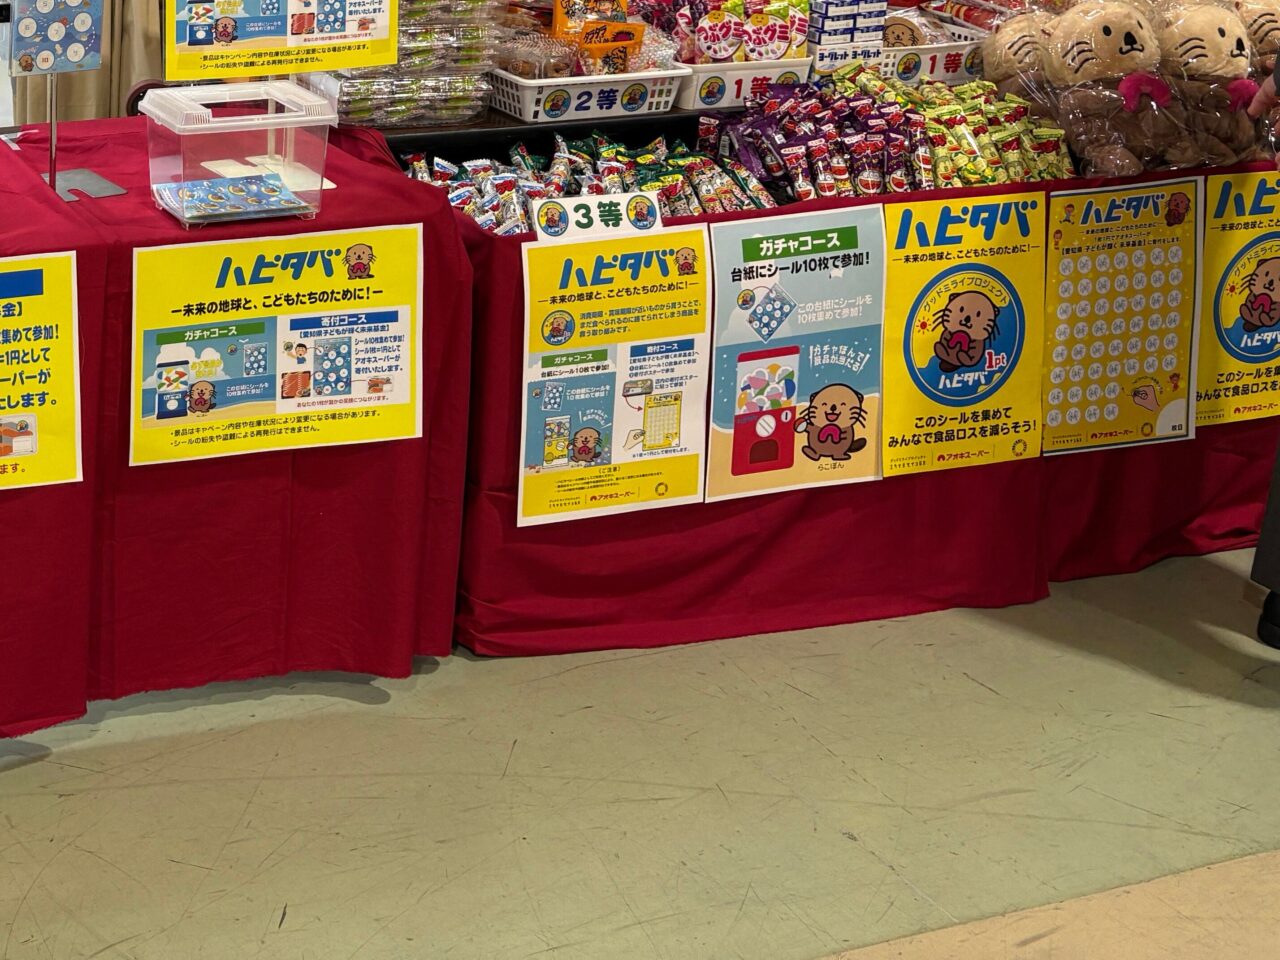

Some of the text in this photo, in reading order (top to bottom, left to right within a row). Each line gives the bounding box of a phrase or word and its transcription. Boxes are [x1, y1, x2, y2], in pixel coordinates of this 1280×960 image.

[819, 51, 849, 61] ヨーグレット
[929, 53, 962, 74] 1等
[734, 77, 772, 99] 1等
[575, 89, 618, 112] 2等
[573, 200, 622, 229] 3等
[760, 232, 840, 256] ガチャコース
[730, 251, 870, 283] 台紙にシール10枚で参加!
[923, 277, 1010, 313] グッドミライプロジェクト
[321, 314, 367, 327] 寄付コース
[184, 326, 238, 341] ガチャコース
[554, 353, 593, 364] ガチャコース
[986, 350, 1006, 370] 1pt
[1196, 380, 1280, 402] みんなで食品ロスを
[914, 406, 1013, 429] このシールを集めて
[888, 419, 1037, 448] みんなで食品ロスを減らそう!
[946, 450, 991, 461] アオキスーパー
